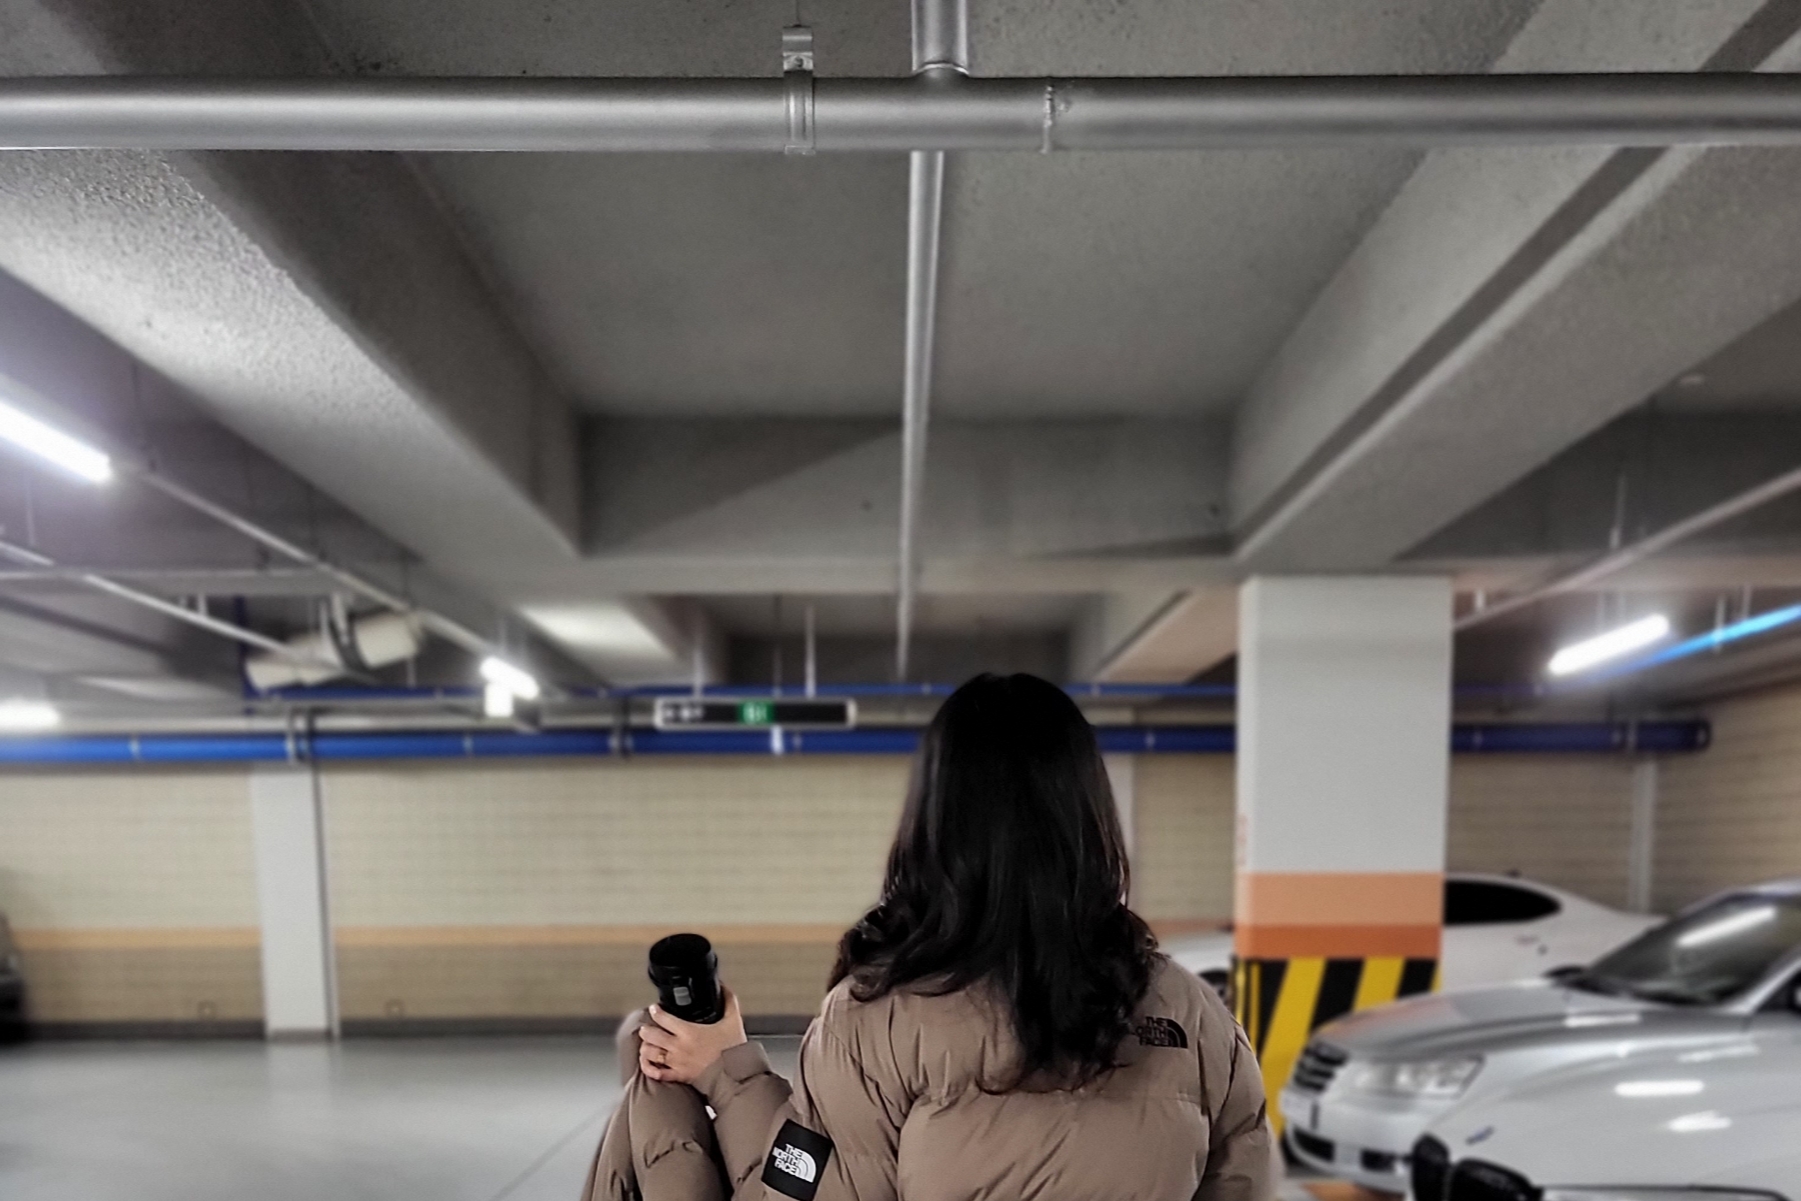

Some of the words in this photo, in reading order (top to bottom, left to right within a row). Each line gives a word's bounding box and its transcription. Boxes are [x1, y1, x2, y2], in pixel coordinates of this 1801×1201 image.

[1145, 1016, 1167, 1028] THE
[1131, 1025, 1168, 1039] ORTH
[772, 1146, 801, 1167] NORTH
[785, 1143, 803, 1158] THE
[774, 1158, 799, 1175] FACE
